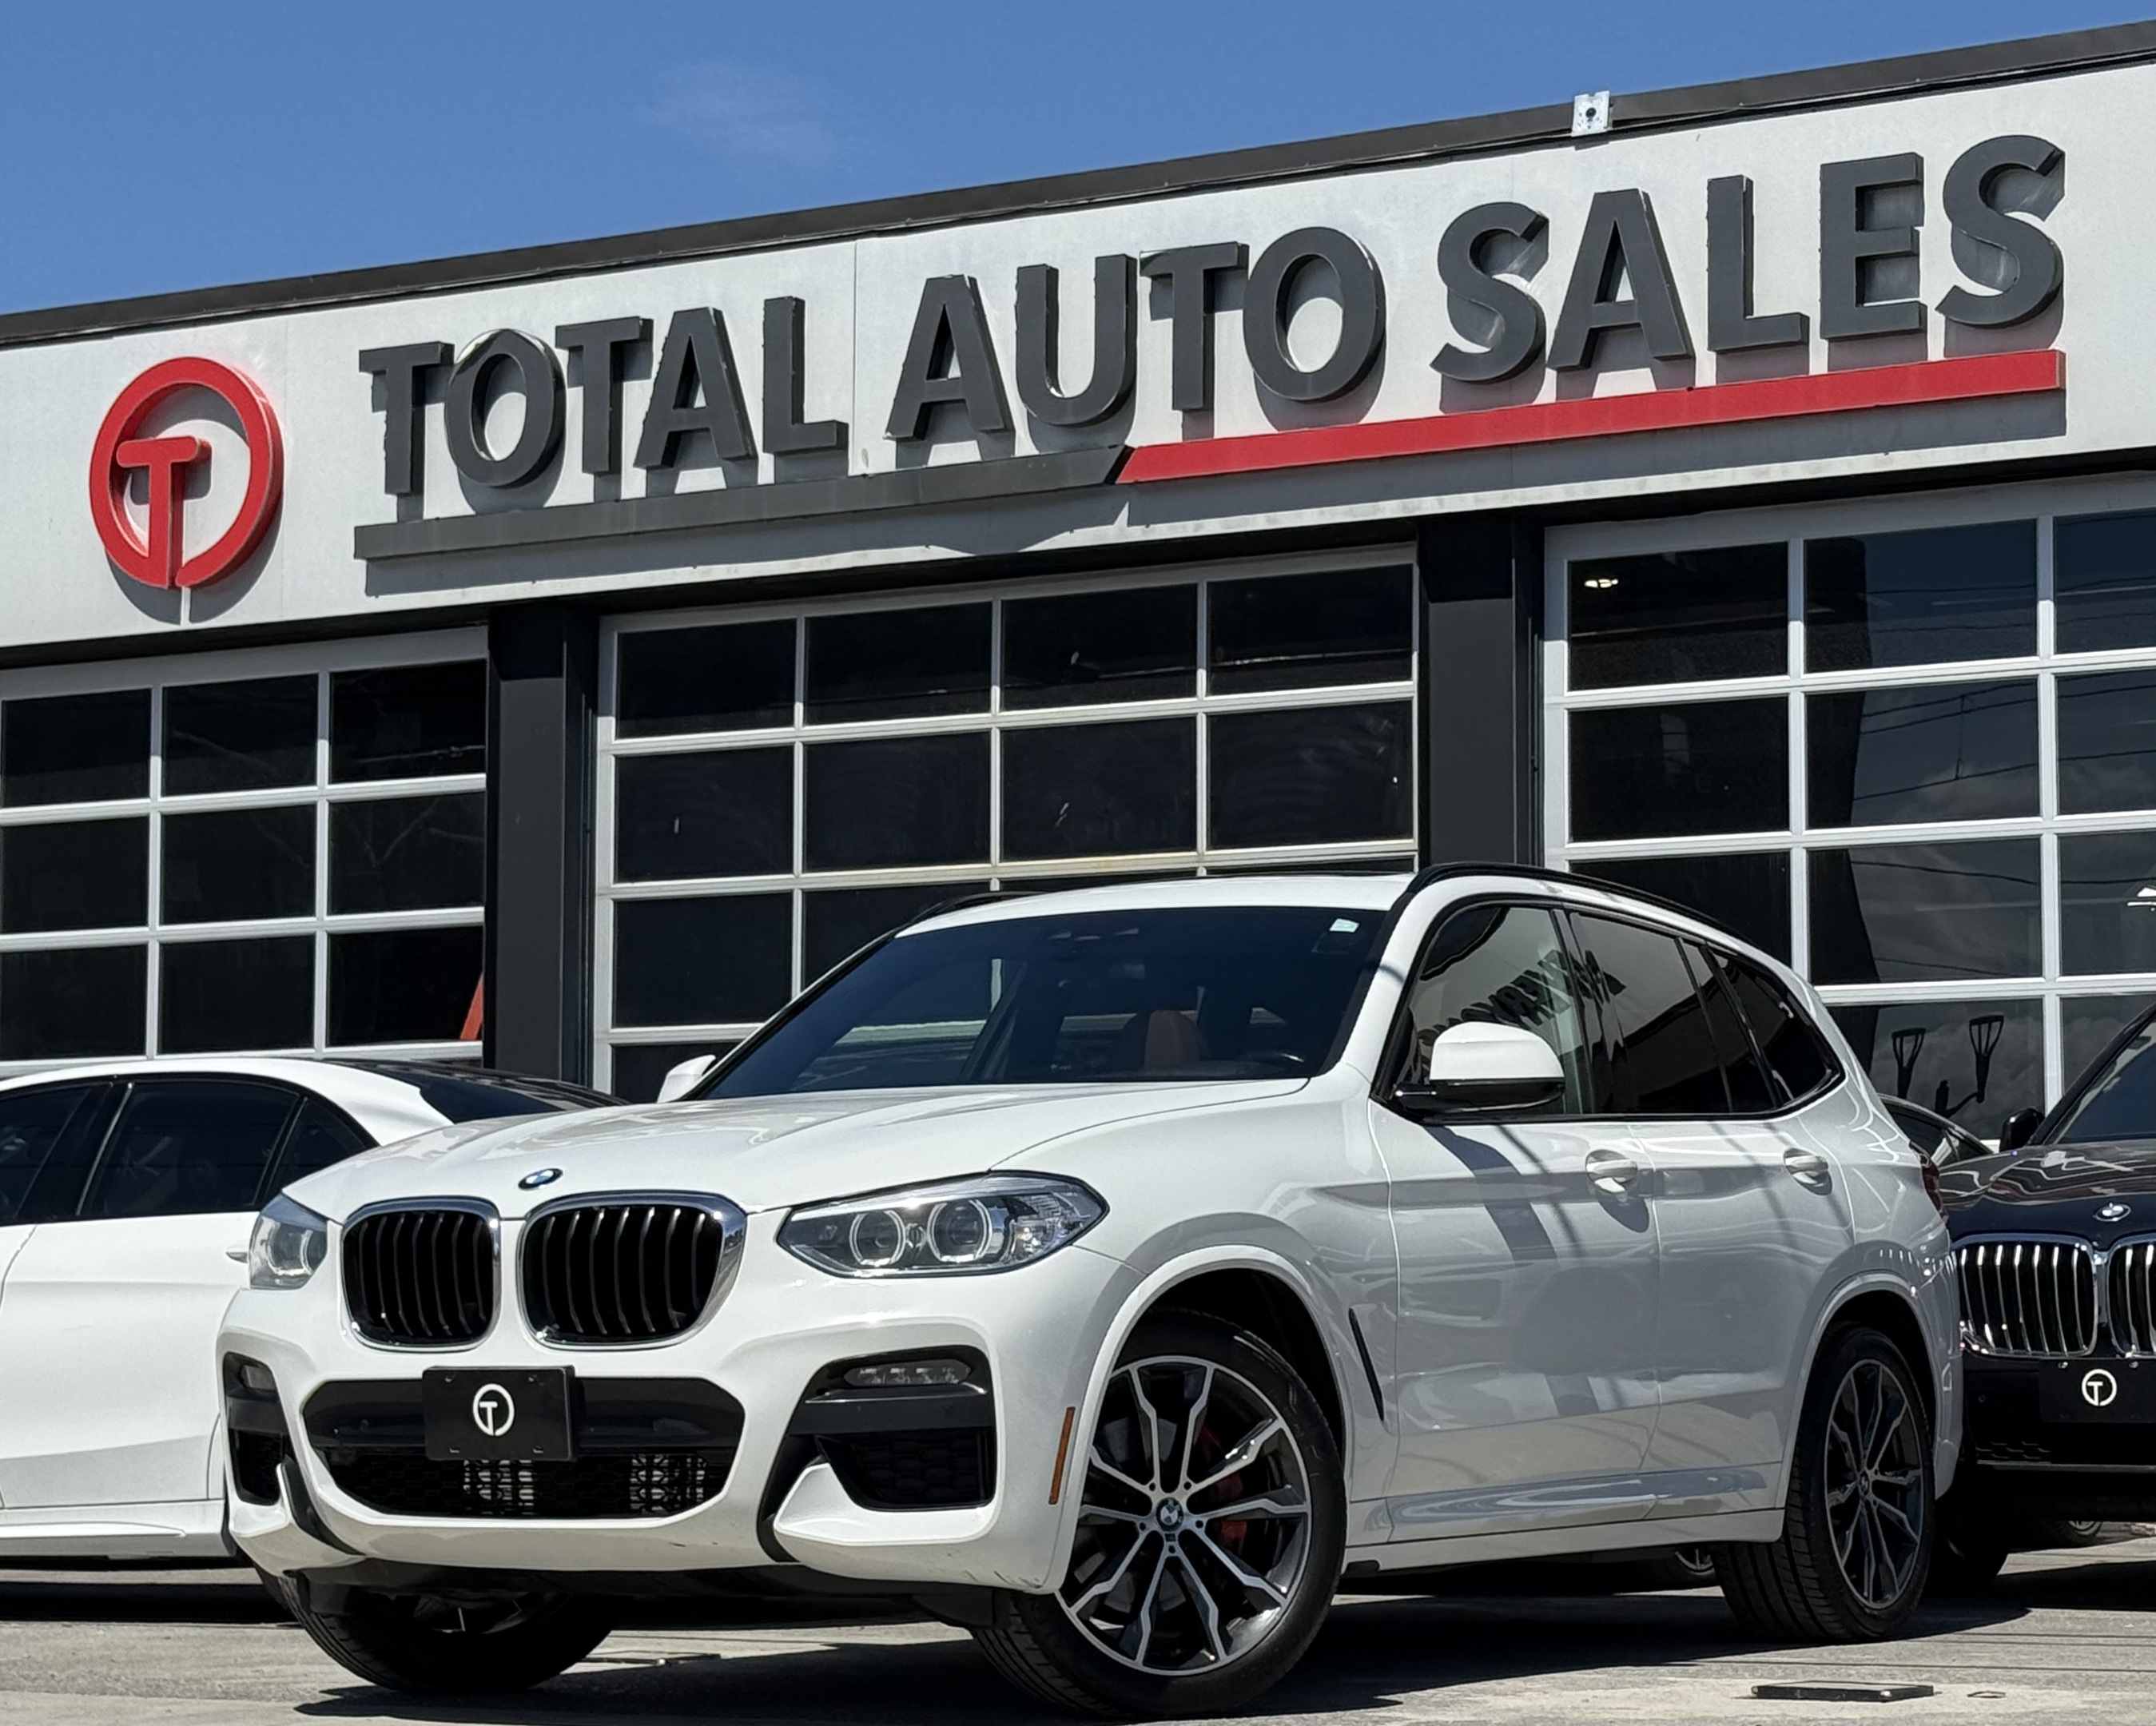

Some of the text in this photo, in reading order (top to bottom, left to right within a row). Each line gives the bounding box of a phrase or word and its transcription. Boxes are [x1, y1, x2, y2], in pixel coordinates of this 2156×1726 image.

[359, 135, 2066, 495] TOTAL AUTO SALES
